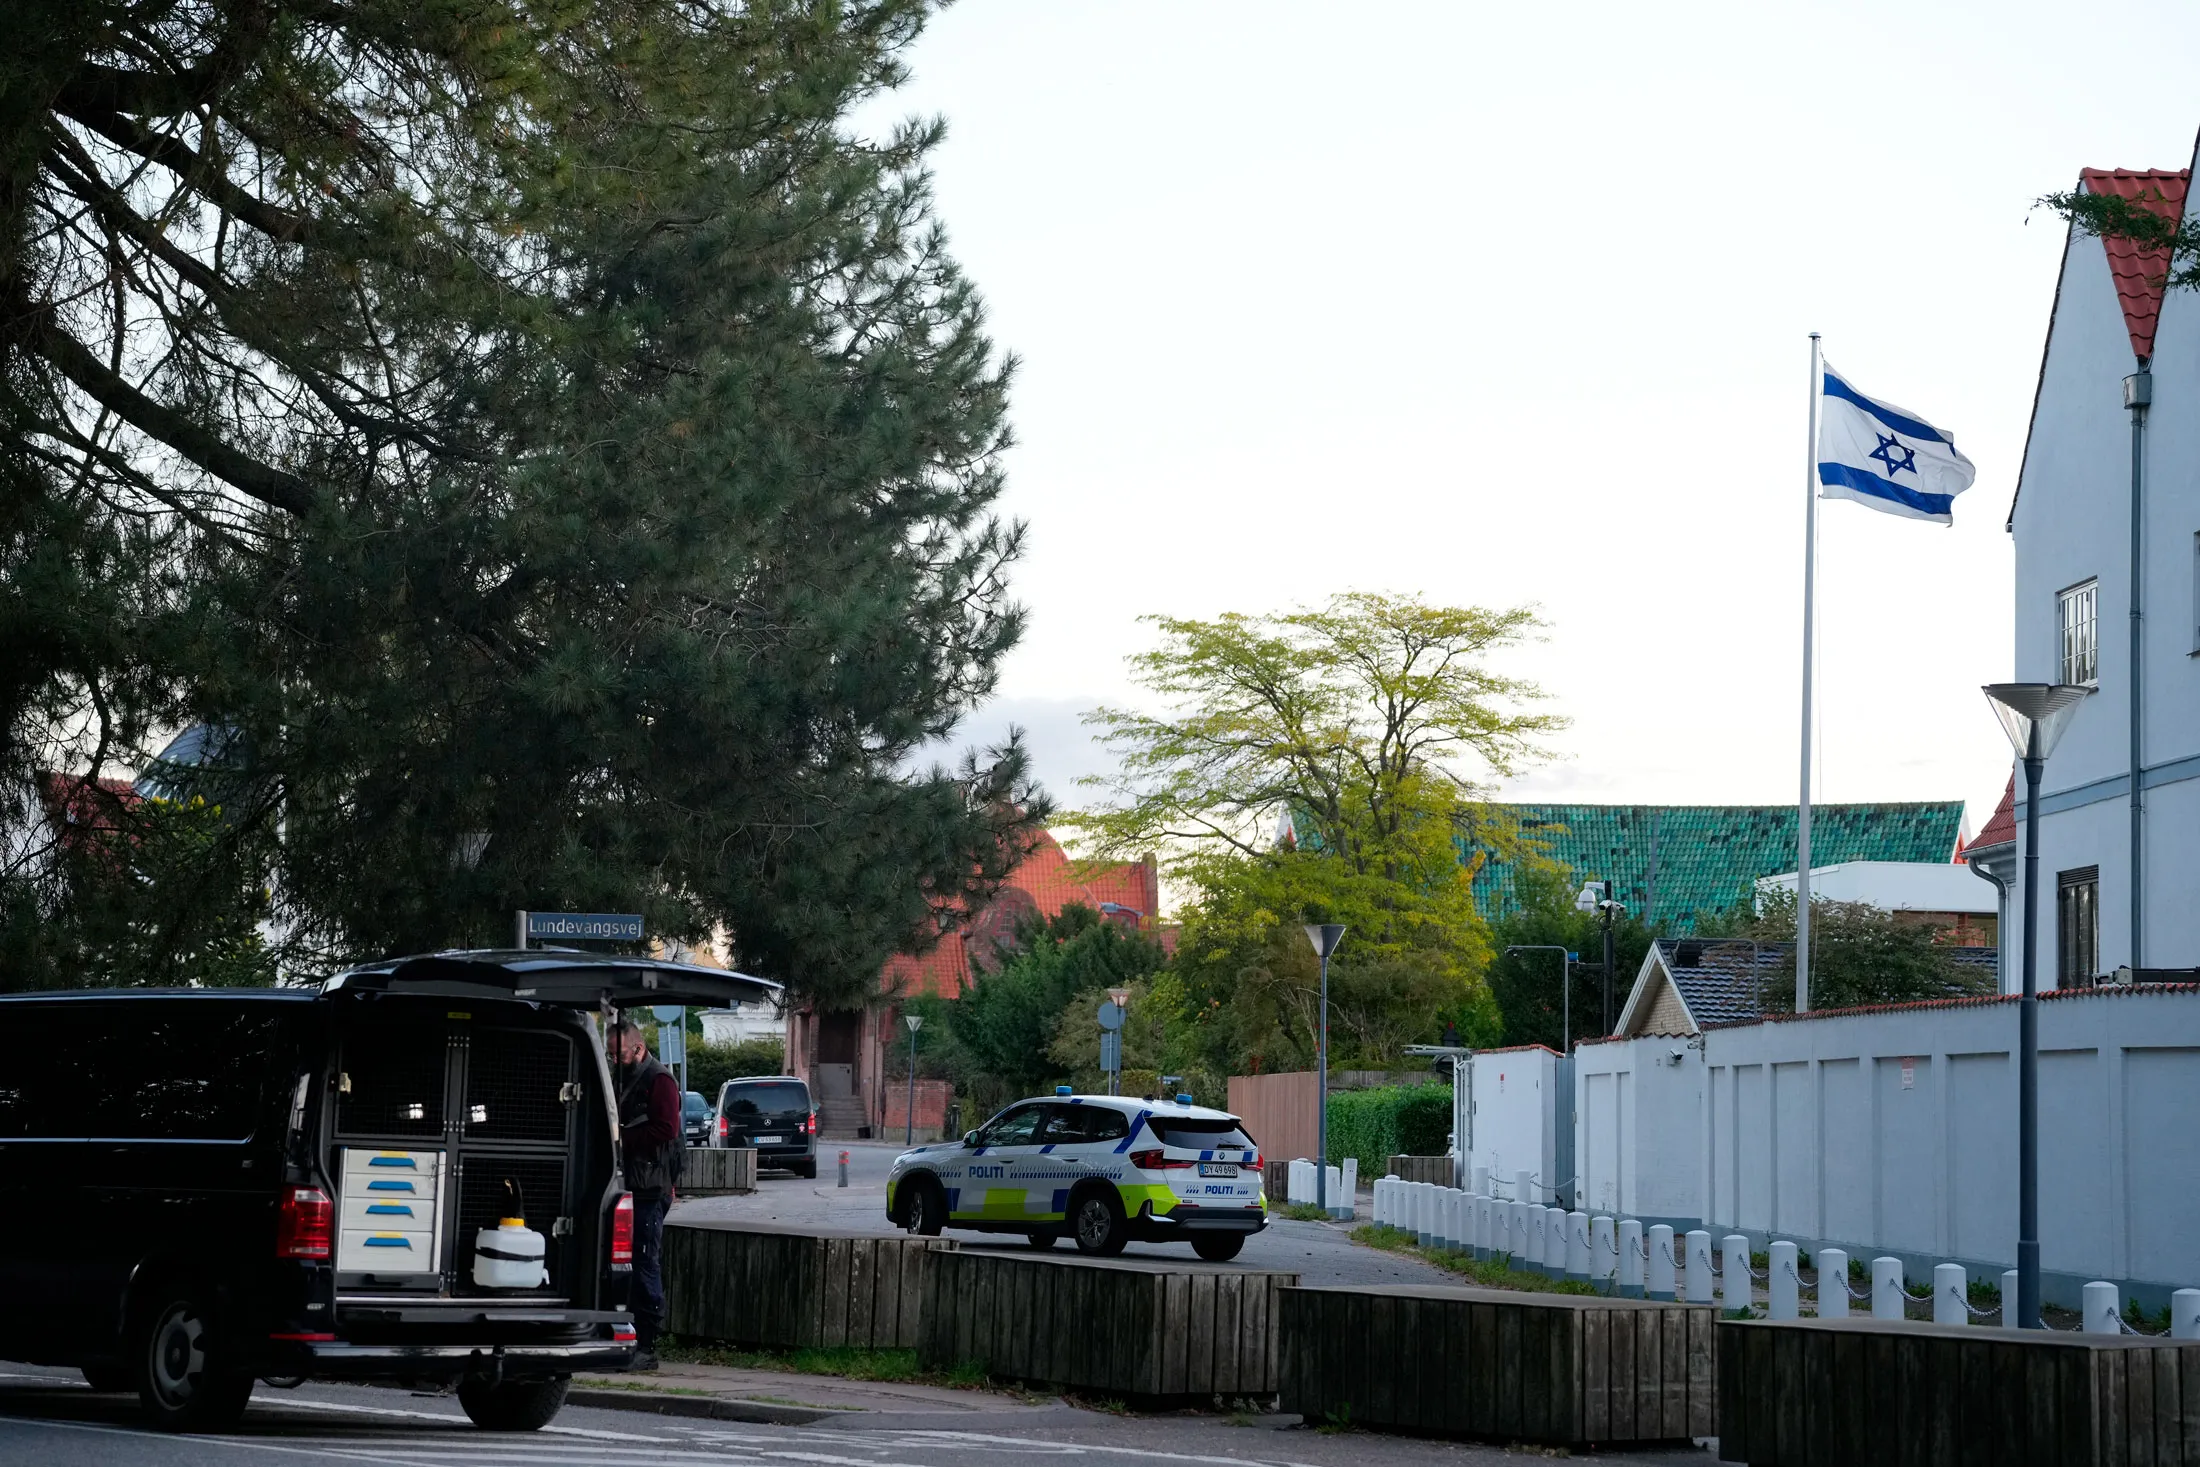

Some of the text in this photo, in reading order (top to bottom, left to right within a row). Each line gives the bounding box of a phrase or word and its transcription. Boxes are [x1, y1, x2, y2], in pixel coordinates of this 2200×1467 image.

[529, 917, 642, 938] Lundevangsvej
[968, 1165, 1004, 1179] POLITI
[1204, 1165, 1214, 1174] DY
[1214, 1165, 1223, 1174] 49
[1204, 1185, 1234, 1195] POLITI
